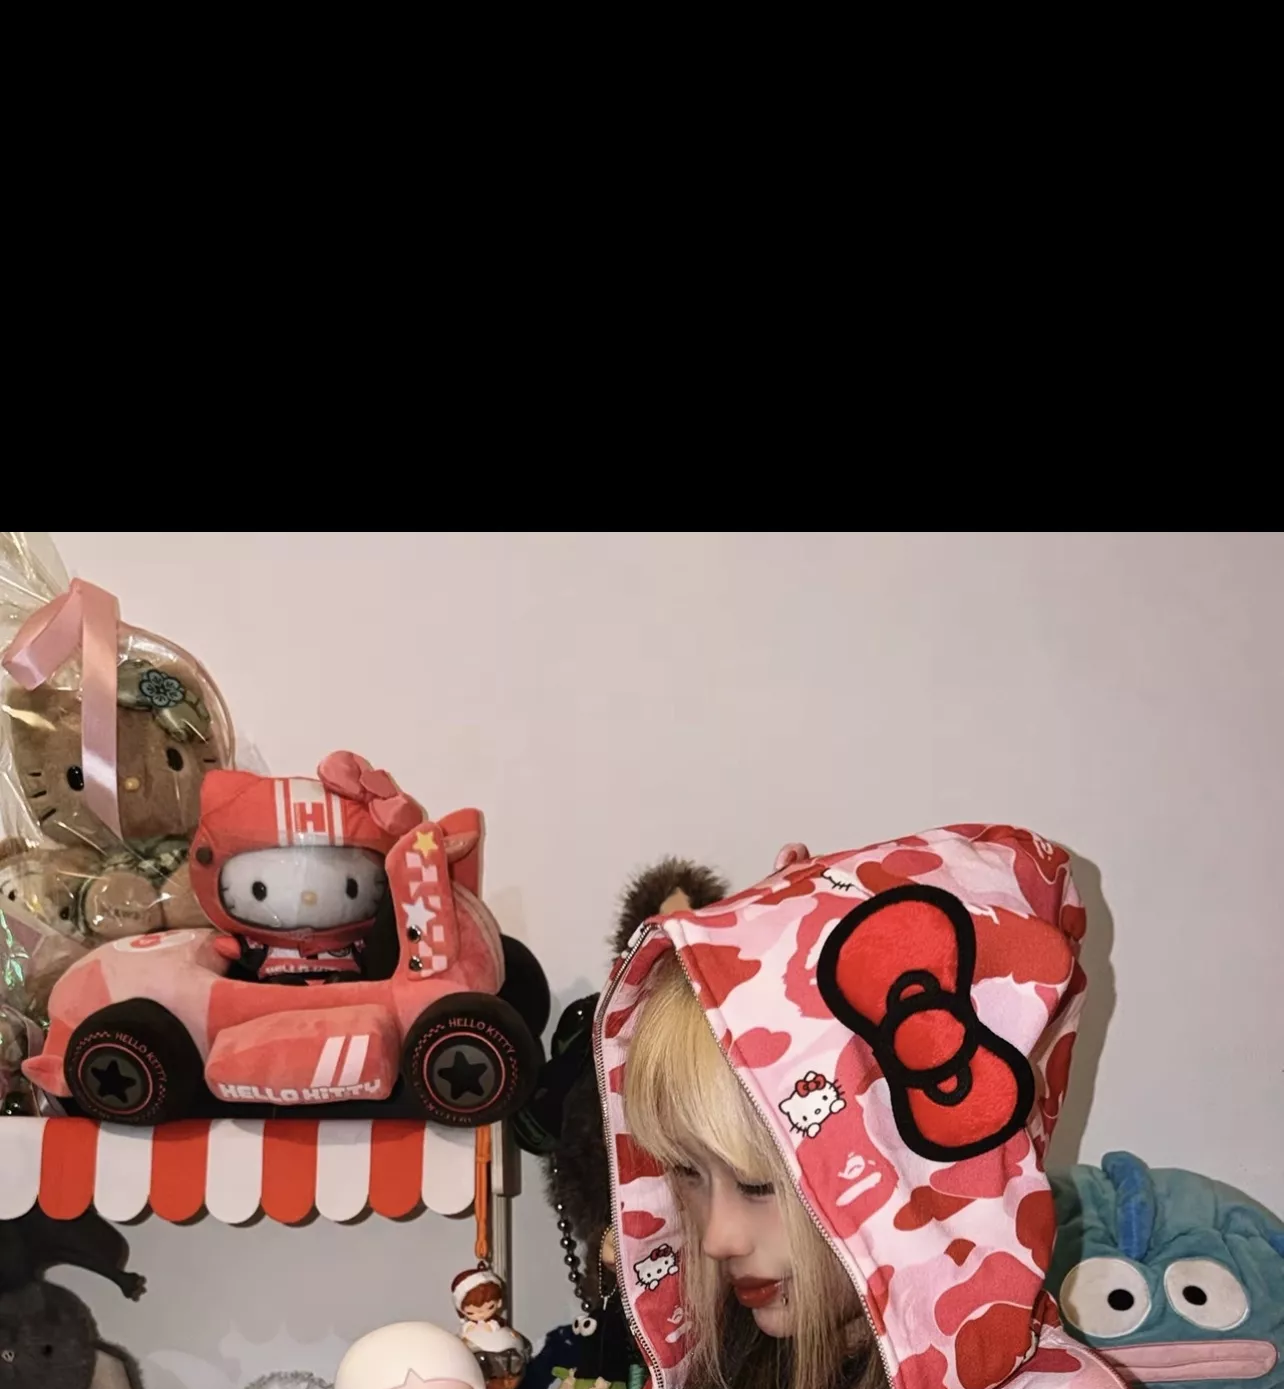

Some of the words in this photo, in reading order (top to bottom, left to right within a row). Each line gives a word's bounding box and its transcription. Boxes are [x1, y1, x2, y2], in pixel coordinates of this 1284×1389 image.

[294, 802, 326, 832] H
[115, 1032, 148, 1053] HELLO
[448, 1018, 486, 1031] HELLO
[485, 1025, 516, 1054] KITTY
[217, 1083, 300, 1101] HELLO
